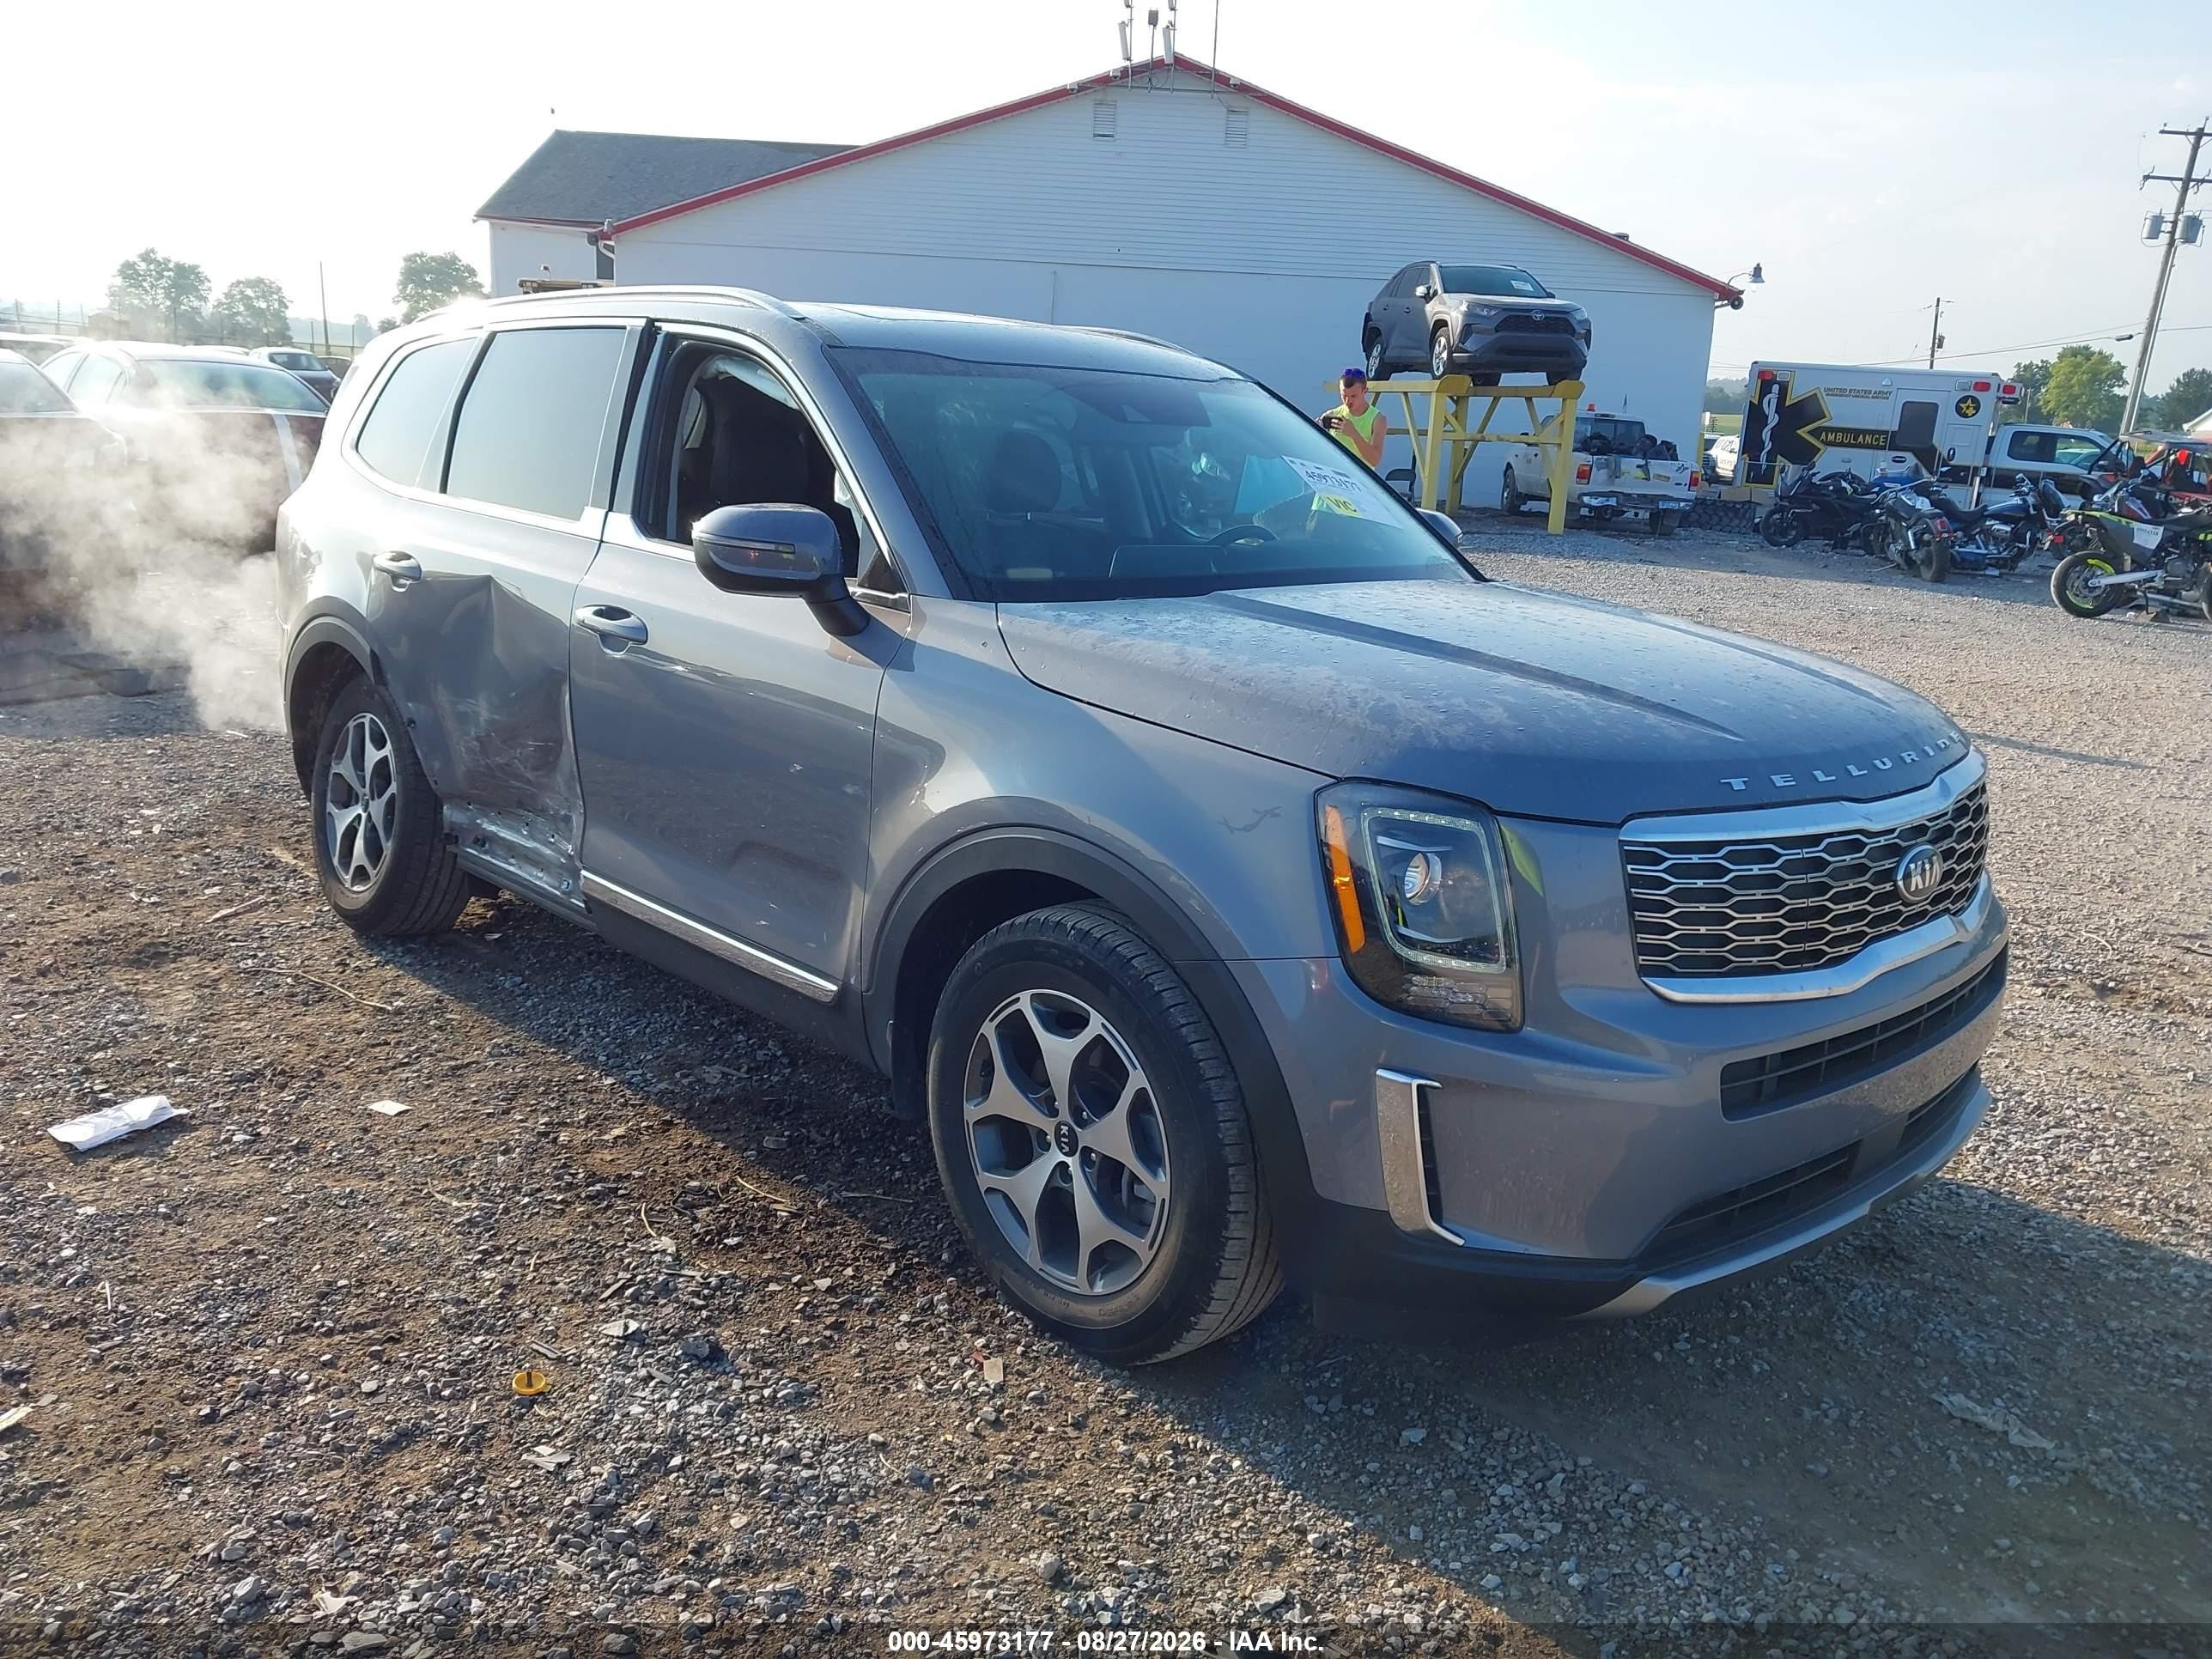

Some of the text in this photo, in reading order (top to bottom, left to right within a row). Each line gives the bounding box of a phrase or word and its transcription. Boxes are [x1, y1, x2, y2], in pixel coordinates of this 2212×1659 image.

[1820, 431, 1887, 446] AMBULANCE
[1305, 470, 1362, 493] 45973177
[1326, 495, 1357, 513] VIC
[1719, 730, 1962, 791] TELLURIDE
[1908, 855, 1940, 892] KIA
[1060, 1125, 1070, 1153] KIA
